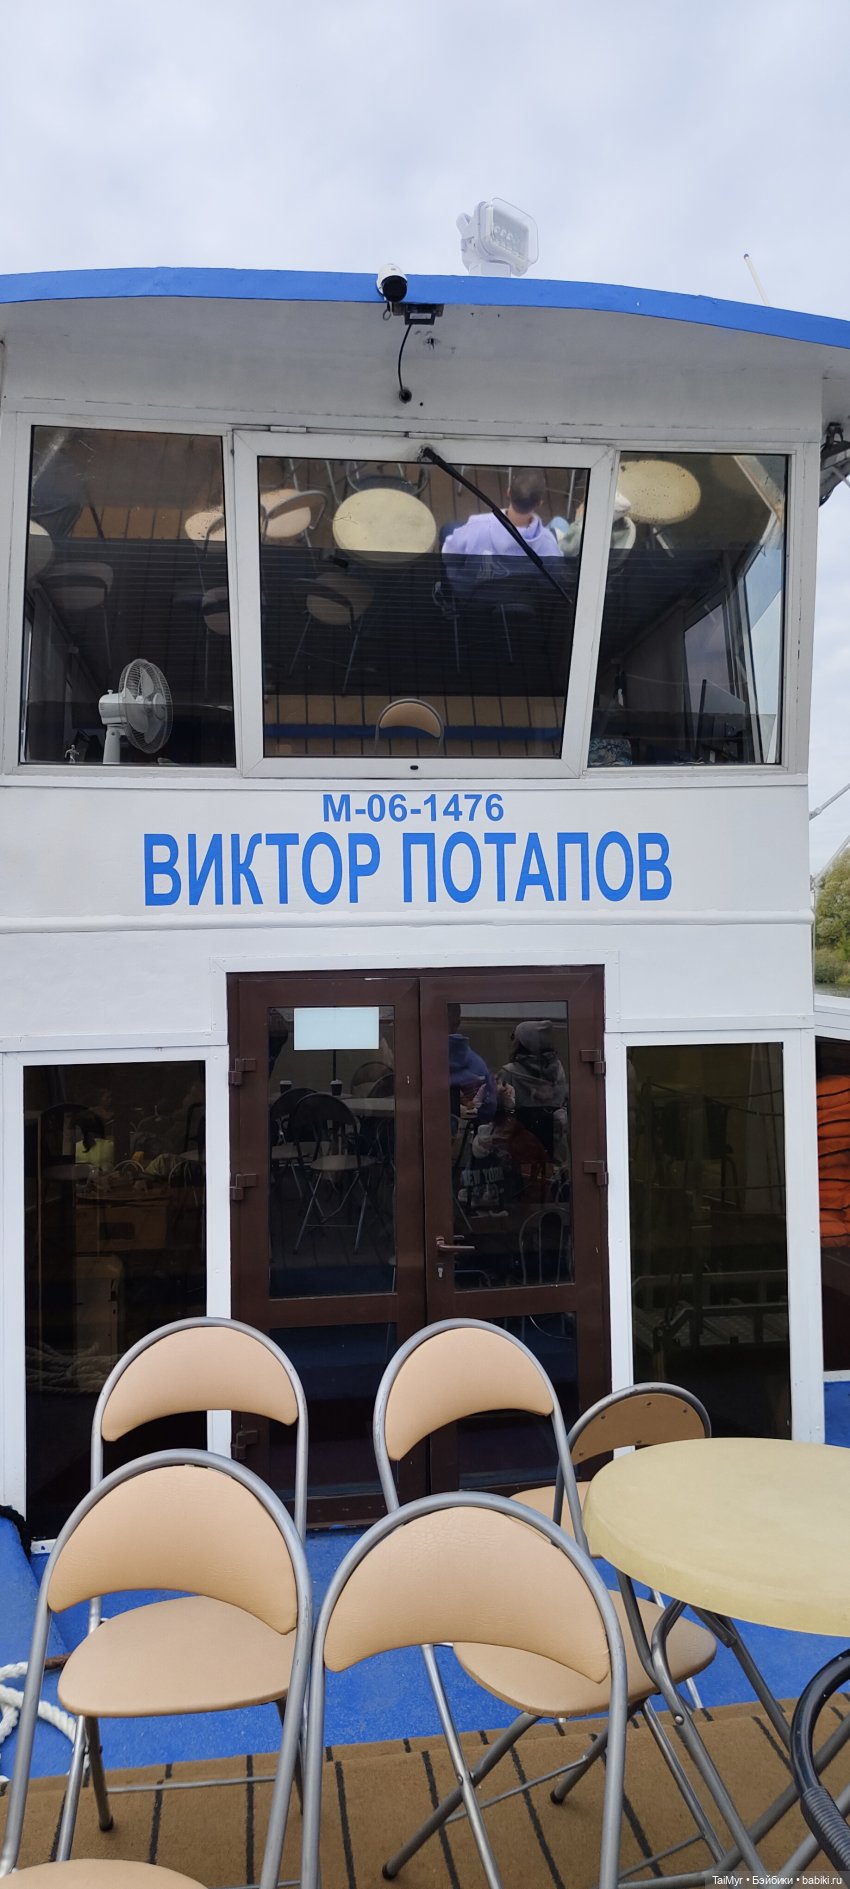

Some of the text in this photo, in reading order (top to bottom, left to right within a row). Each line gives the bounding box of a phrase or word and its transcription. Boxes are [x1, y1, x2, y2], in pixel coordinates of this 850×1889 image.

[323, 793, 504, 822] М-06-1476
[143, 830, 673, 906] ВИКТОР ПОТАПОВ
